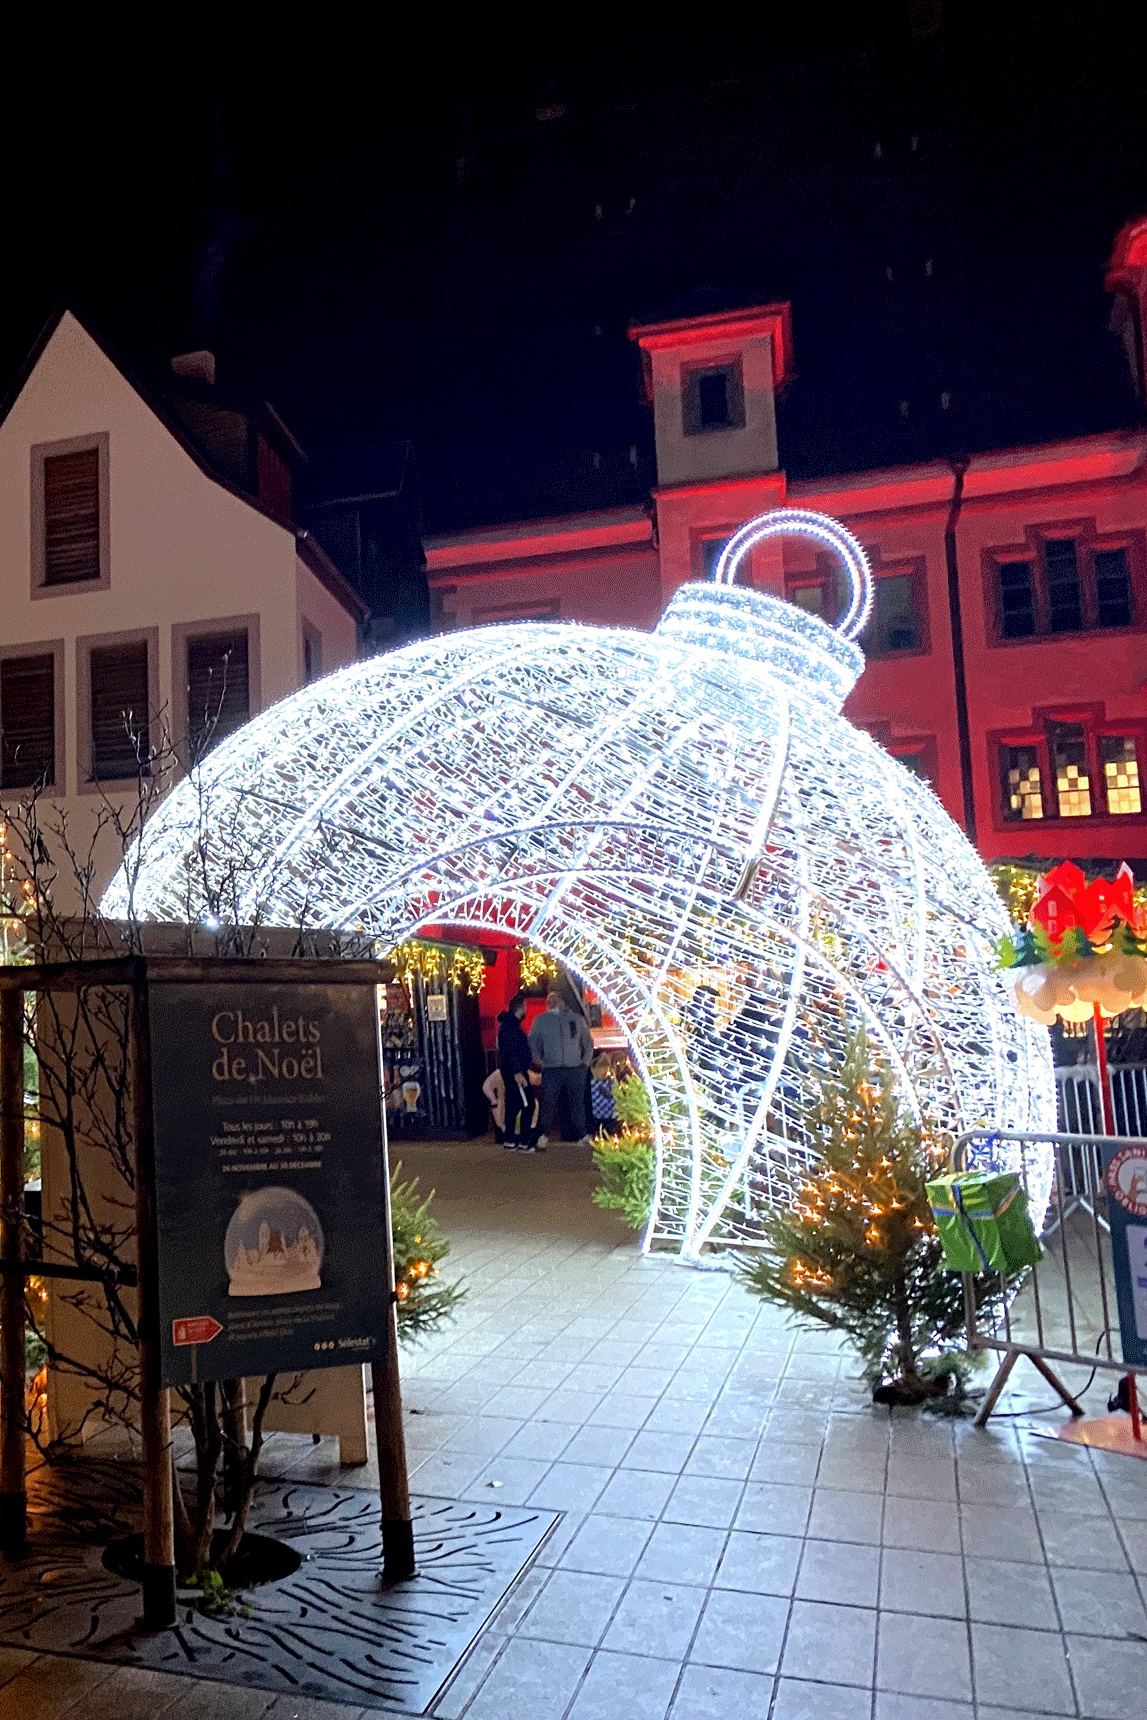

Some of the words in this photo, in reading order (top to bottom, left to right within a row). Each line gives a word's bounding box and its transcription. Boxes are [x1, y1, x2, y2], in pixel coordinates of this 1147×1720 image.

[211, 1005, 320, 1043] Chalets
[211, 1046, 246, 1081] de
[256, 1045, 323, 1080] Noël
